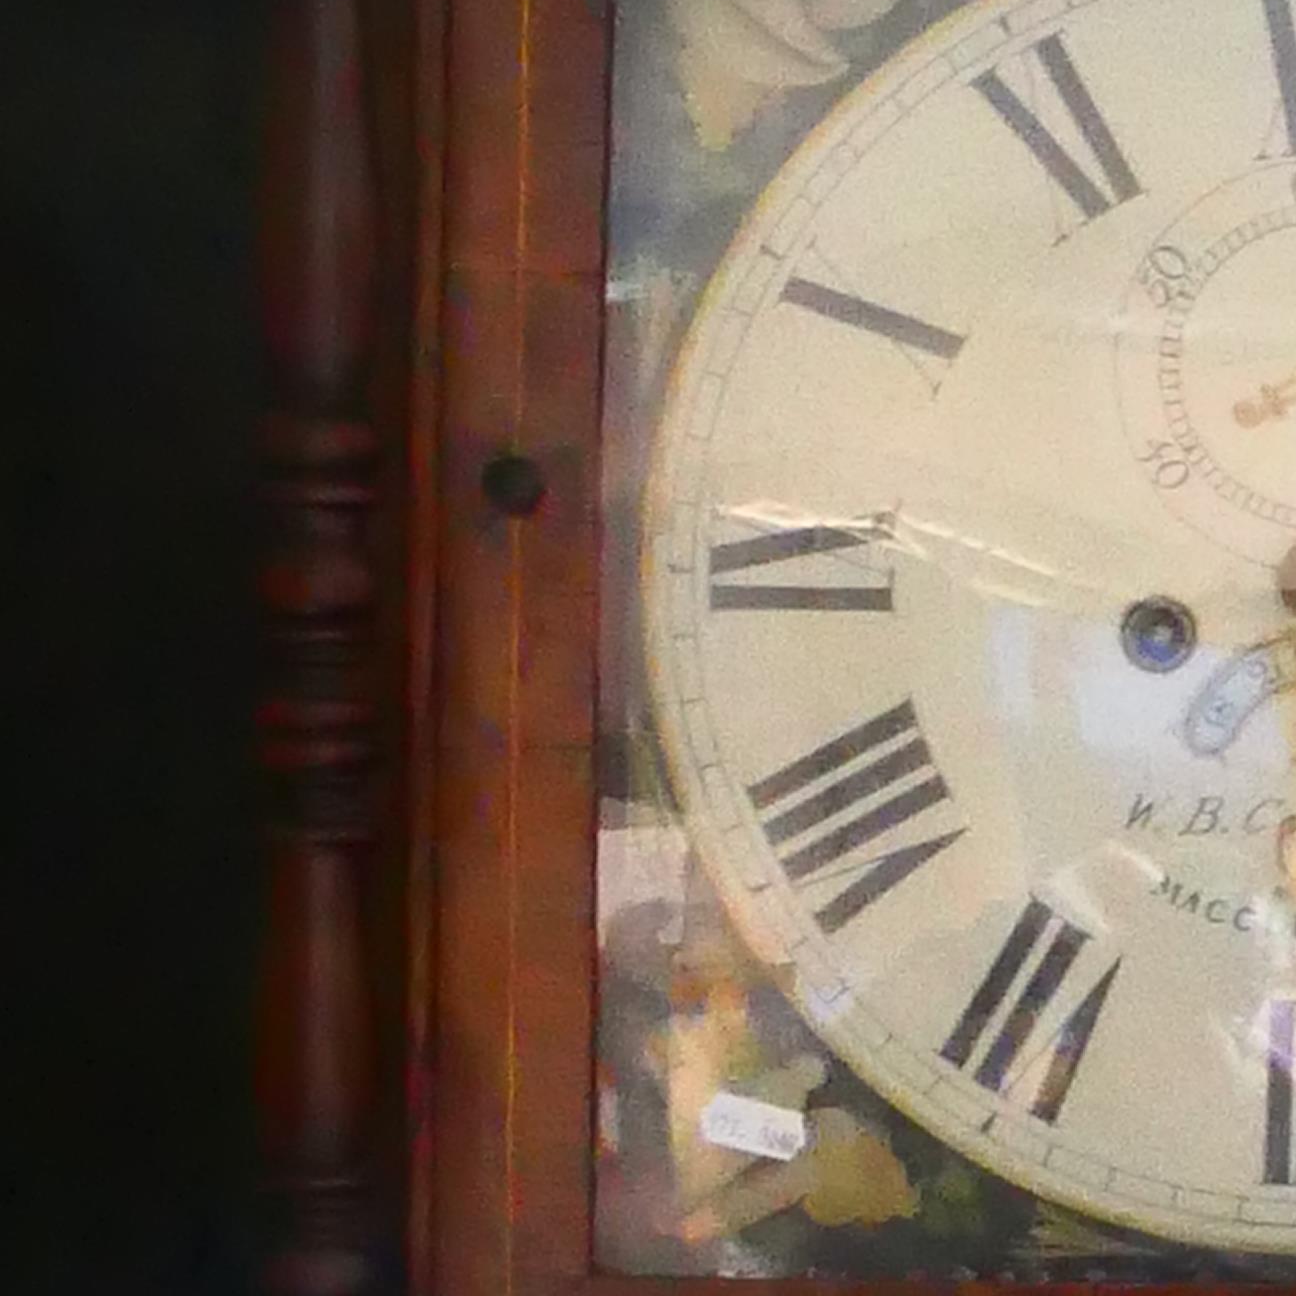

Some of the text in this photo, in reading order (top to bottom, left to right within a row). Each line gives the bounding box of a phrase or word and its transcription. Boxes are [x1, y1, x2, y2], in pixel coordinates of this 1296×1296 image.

[969, 29, 1149, 247] XI
[746, 692, 971, 934] VIII
[938, 891, 1123, 1125] VII
